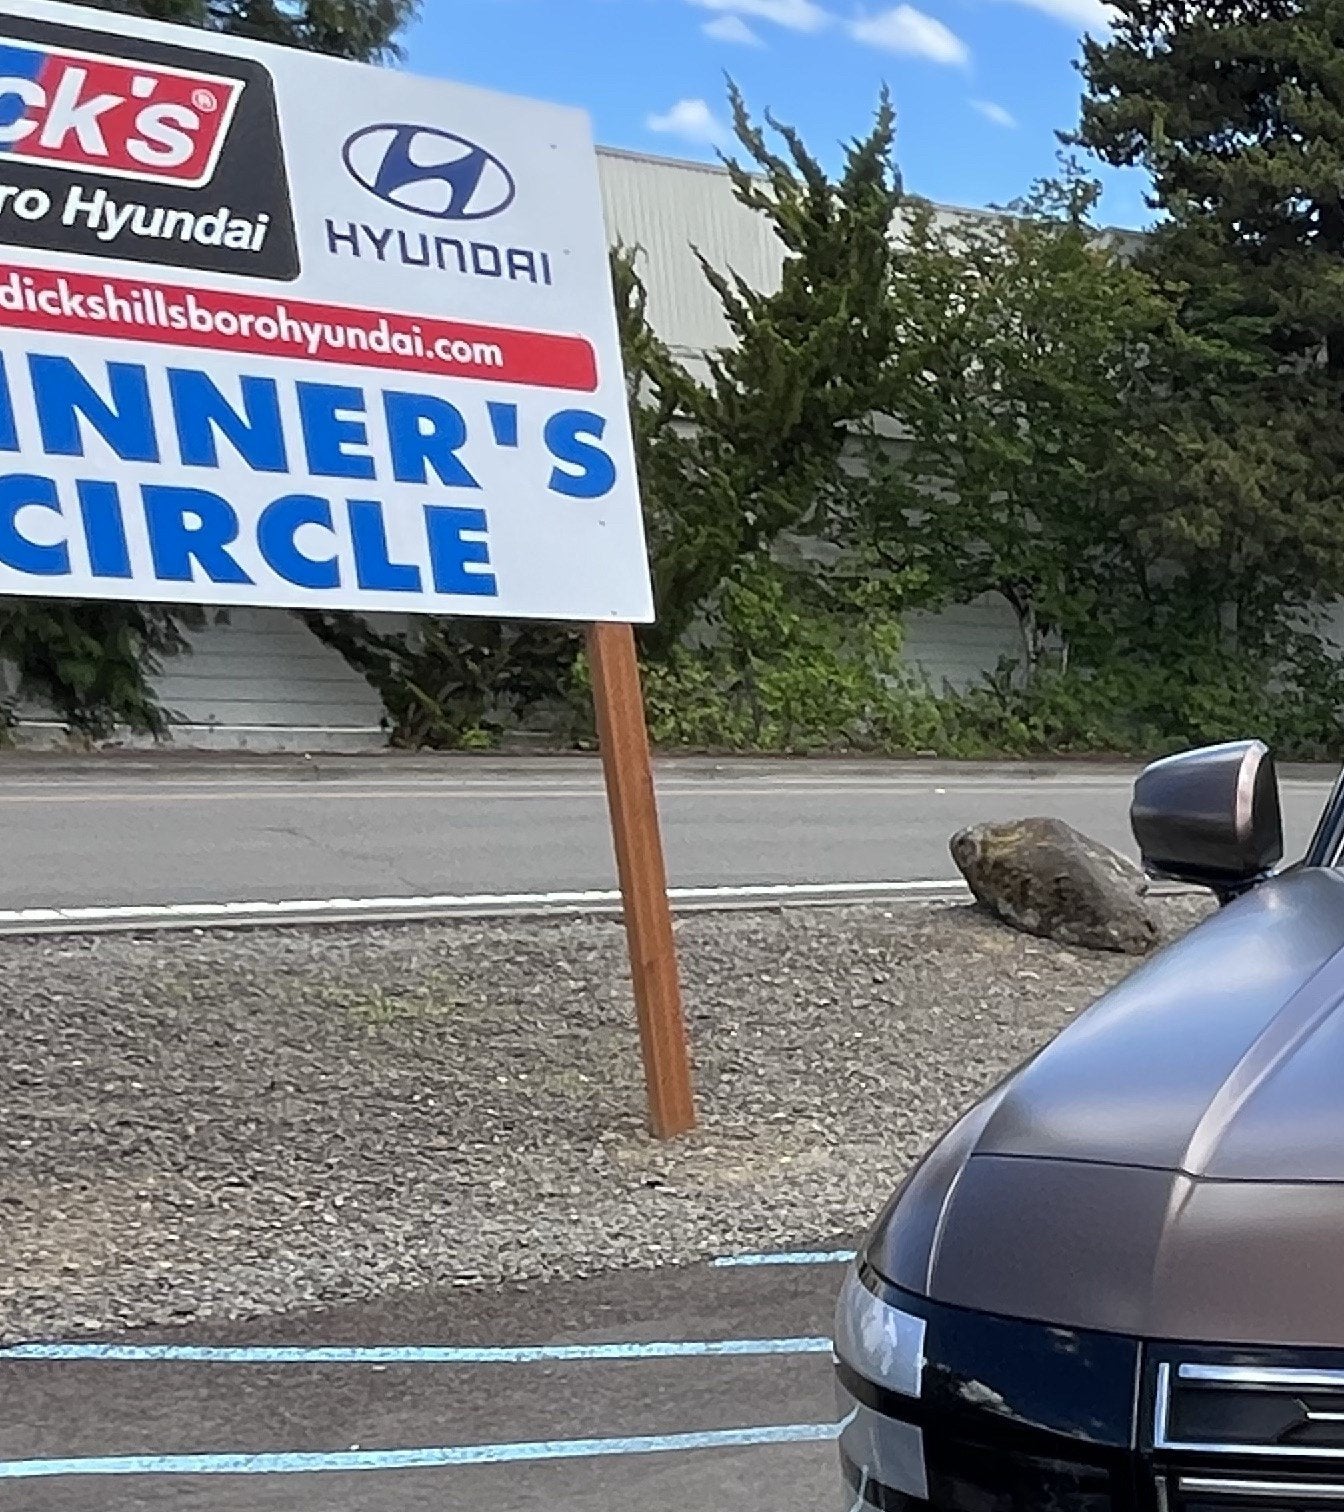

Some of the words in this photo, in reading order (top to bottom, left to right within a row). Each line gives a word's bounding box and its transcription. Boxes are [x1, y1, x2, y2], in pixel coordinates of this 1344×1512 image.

[62, 186, 270, 252] Hyundai
[325, 219, 552, 286] HYUNDAI
[0, 272, 503, 367] dickshillsborohyundai.com
[0, 474, 498, 597] CIRCLE
